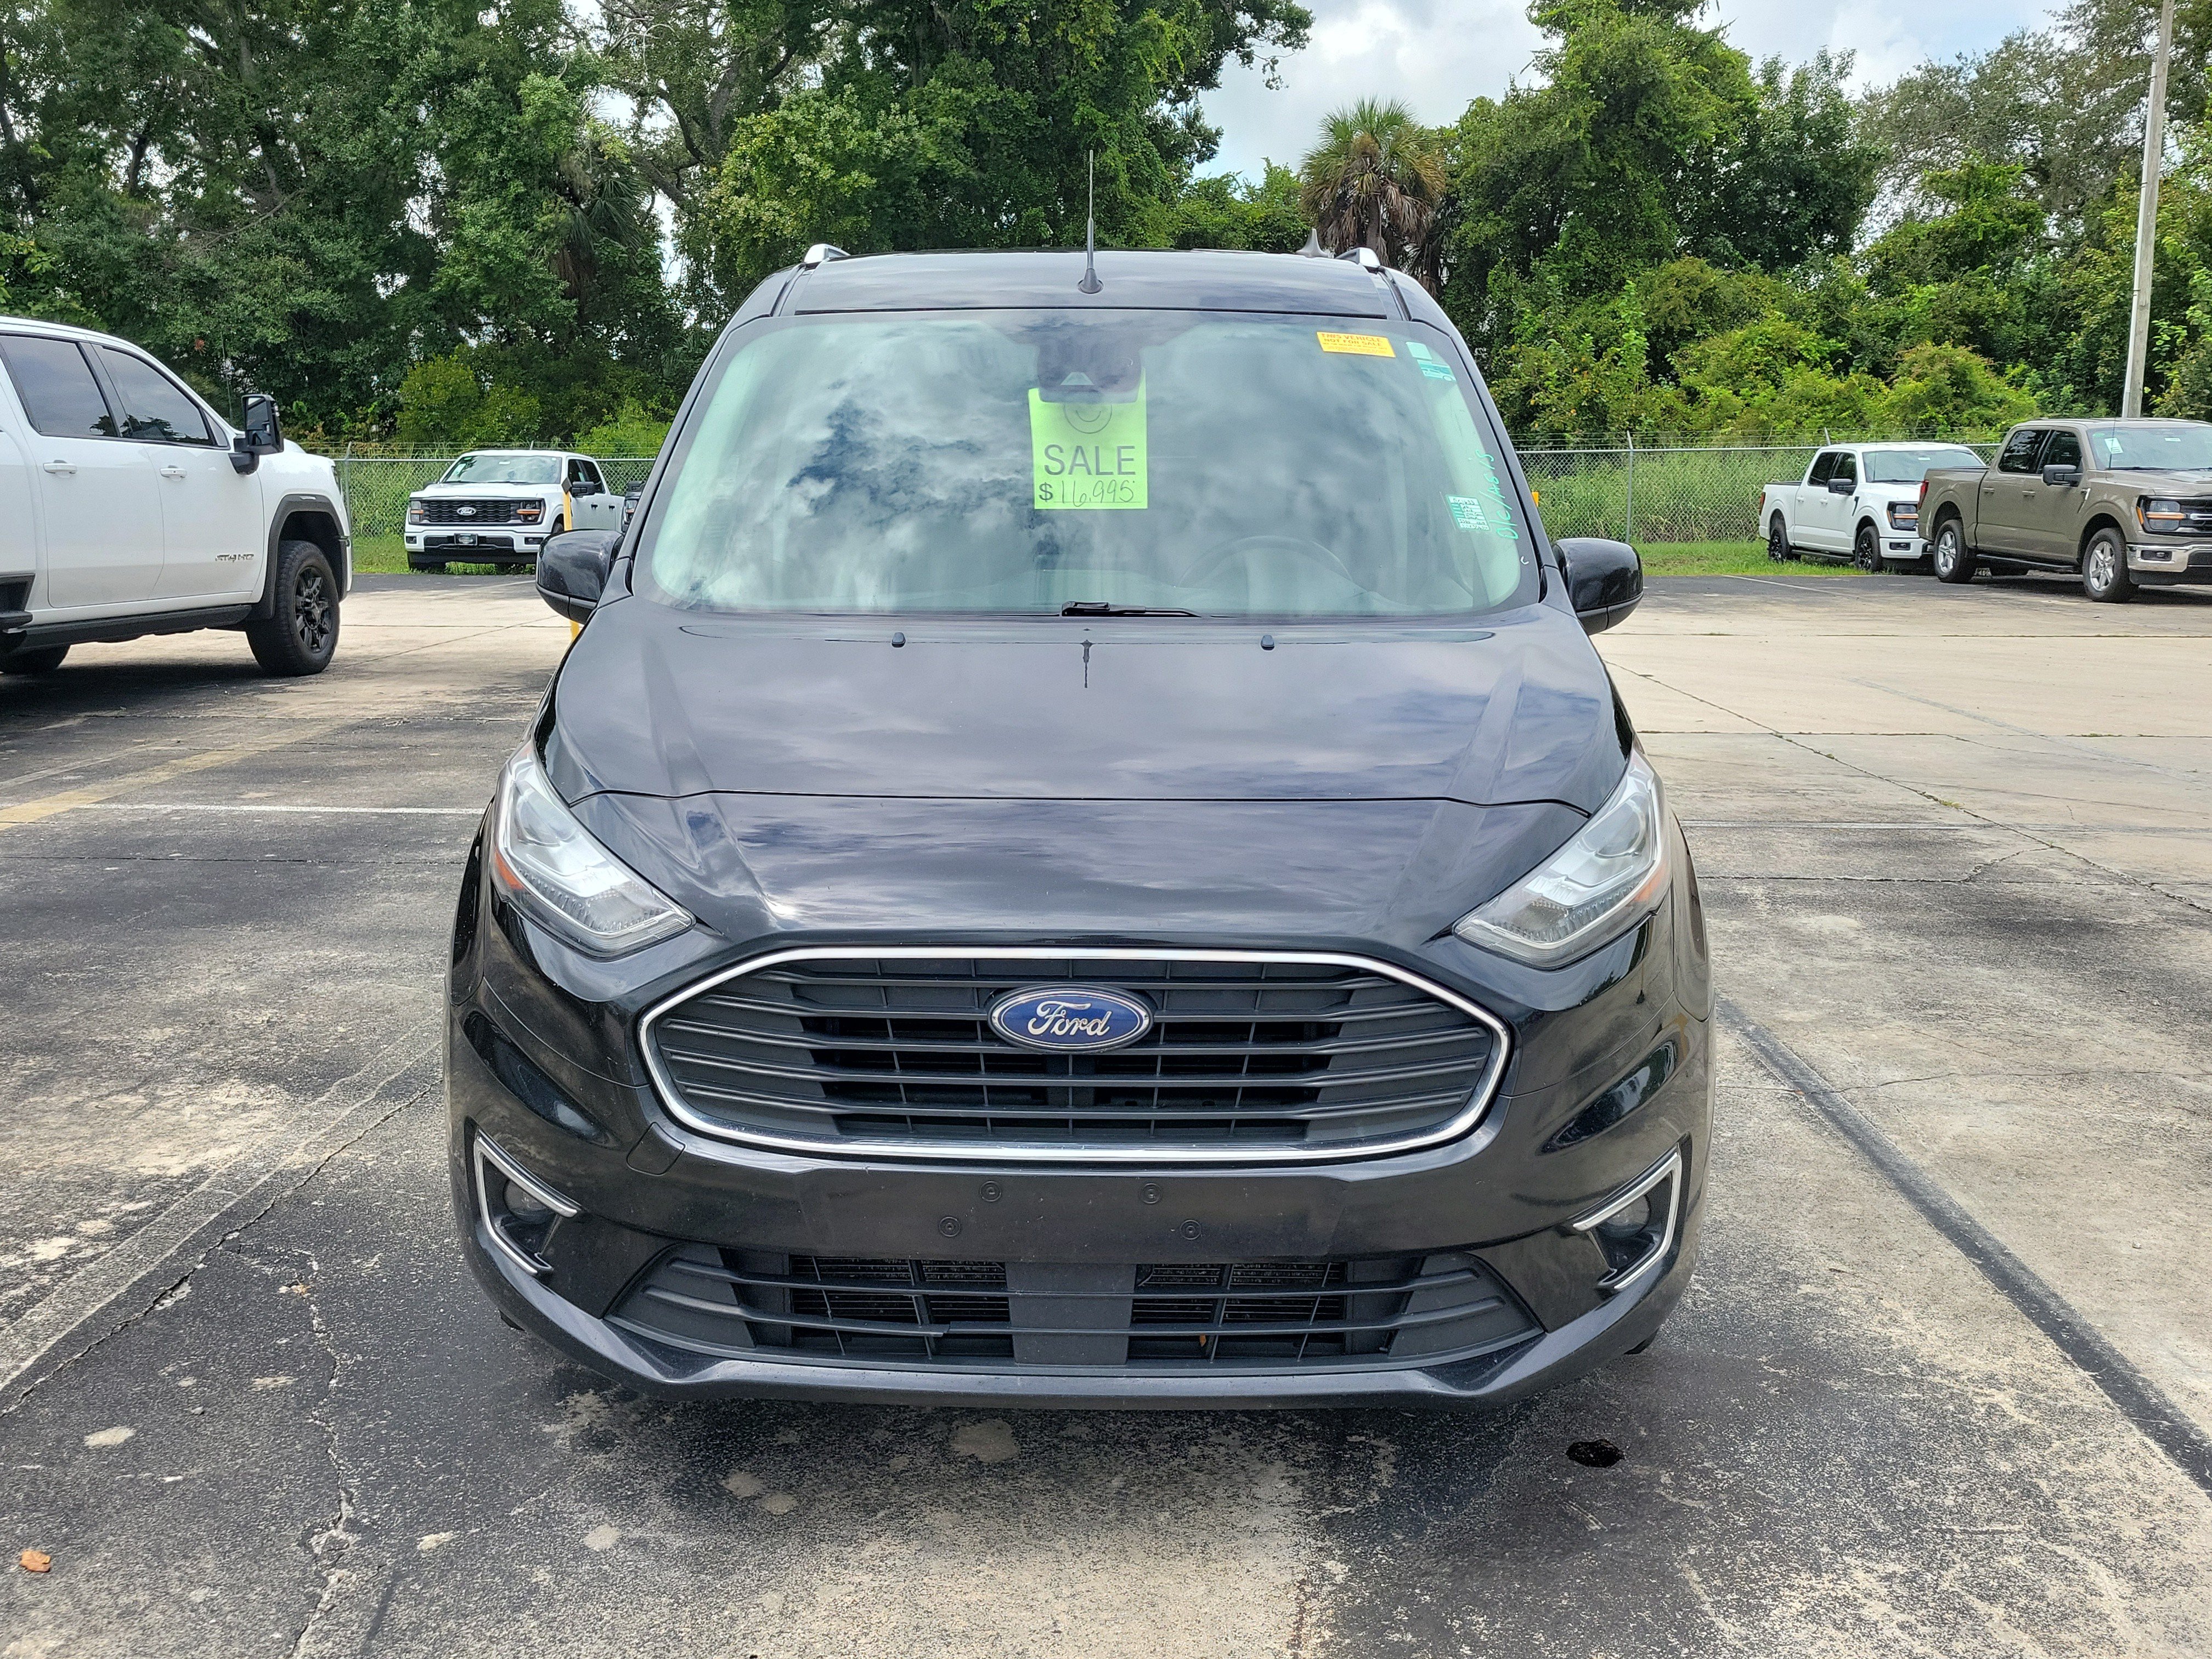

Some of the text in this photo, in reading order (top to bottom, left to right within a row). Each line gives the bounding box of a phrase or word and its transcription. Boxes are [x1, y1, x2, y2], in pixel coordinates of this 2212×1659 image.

[1344, 335, 1383, 343] VEHICLE
[1044, 444, 1136, 476] SALE
[1027, 1000, 1112, 1036] Ford
